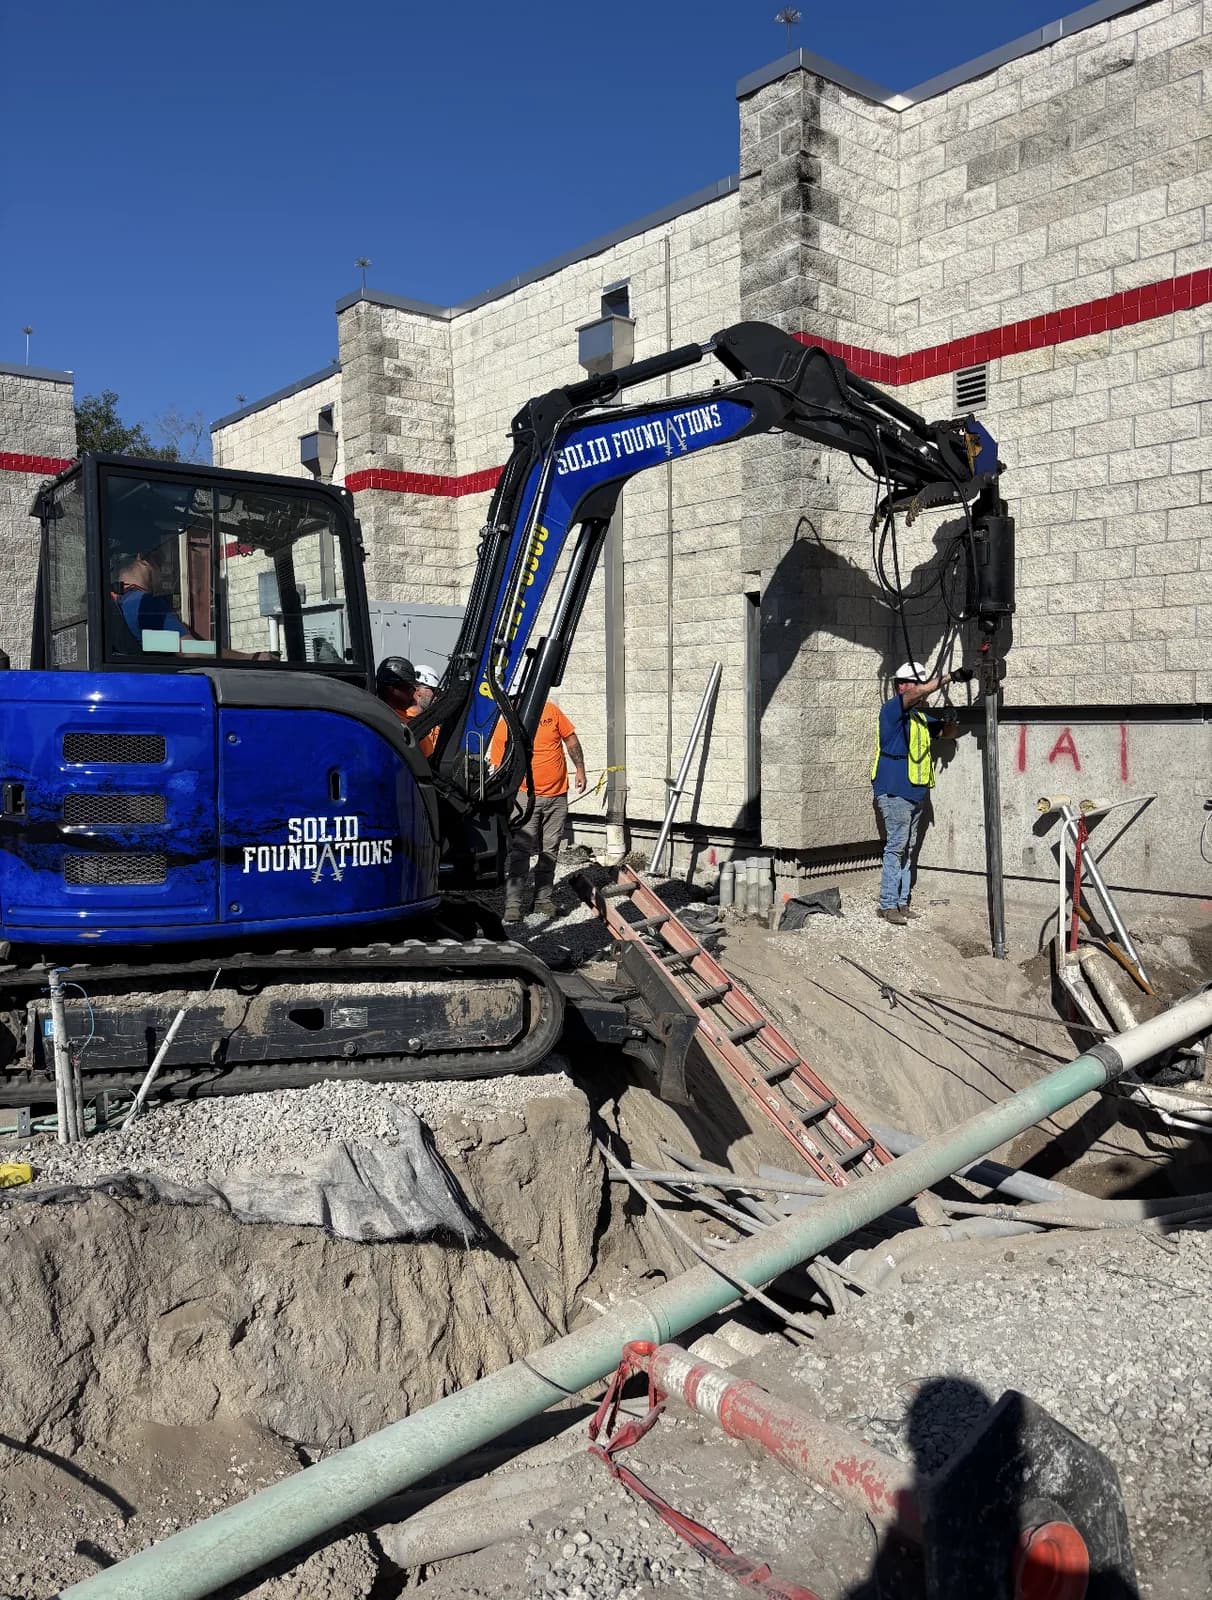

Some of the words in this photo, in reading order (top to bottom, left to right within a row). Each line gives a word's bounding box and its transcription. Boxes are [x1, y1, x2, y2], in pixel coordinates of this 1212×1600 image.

[556, 436, 611, 475] SOLID
[612, 404, 722, 456] FOUNDATIONS
[288, 816, 359, 844] SOLID
[242, 839, 393, 884] FOUNDATIONS
